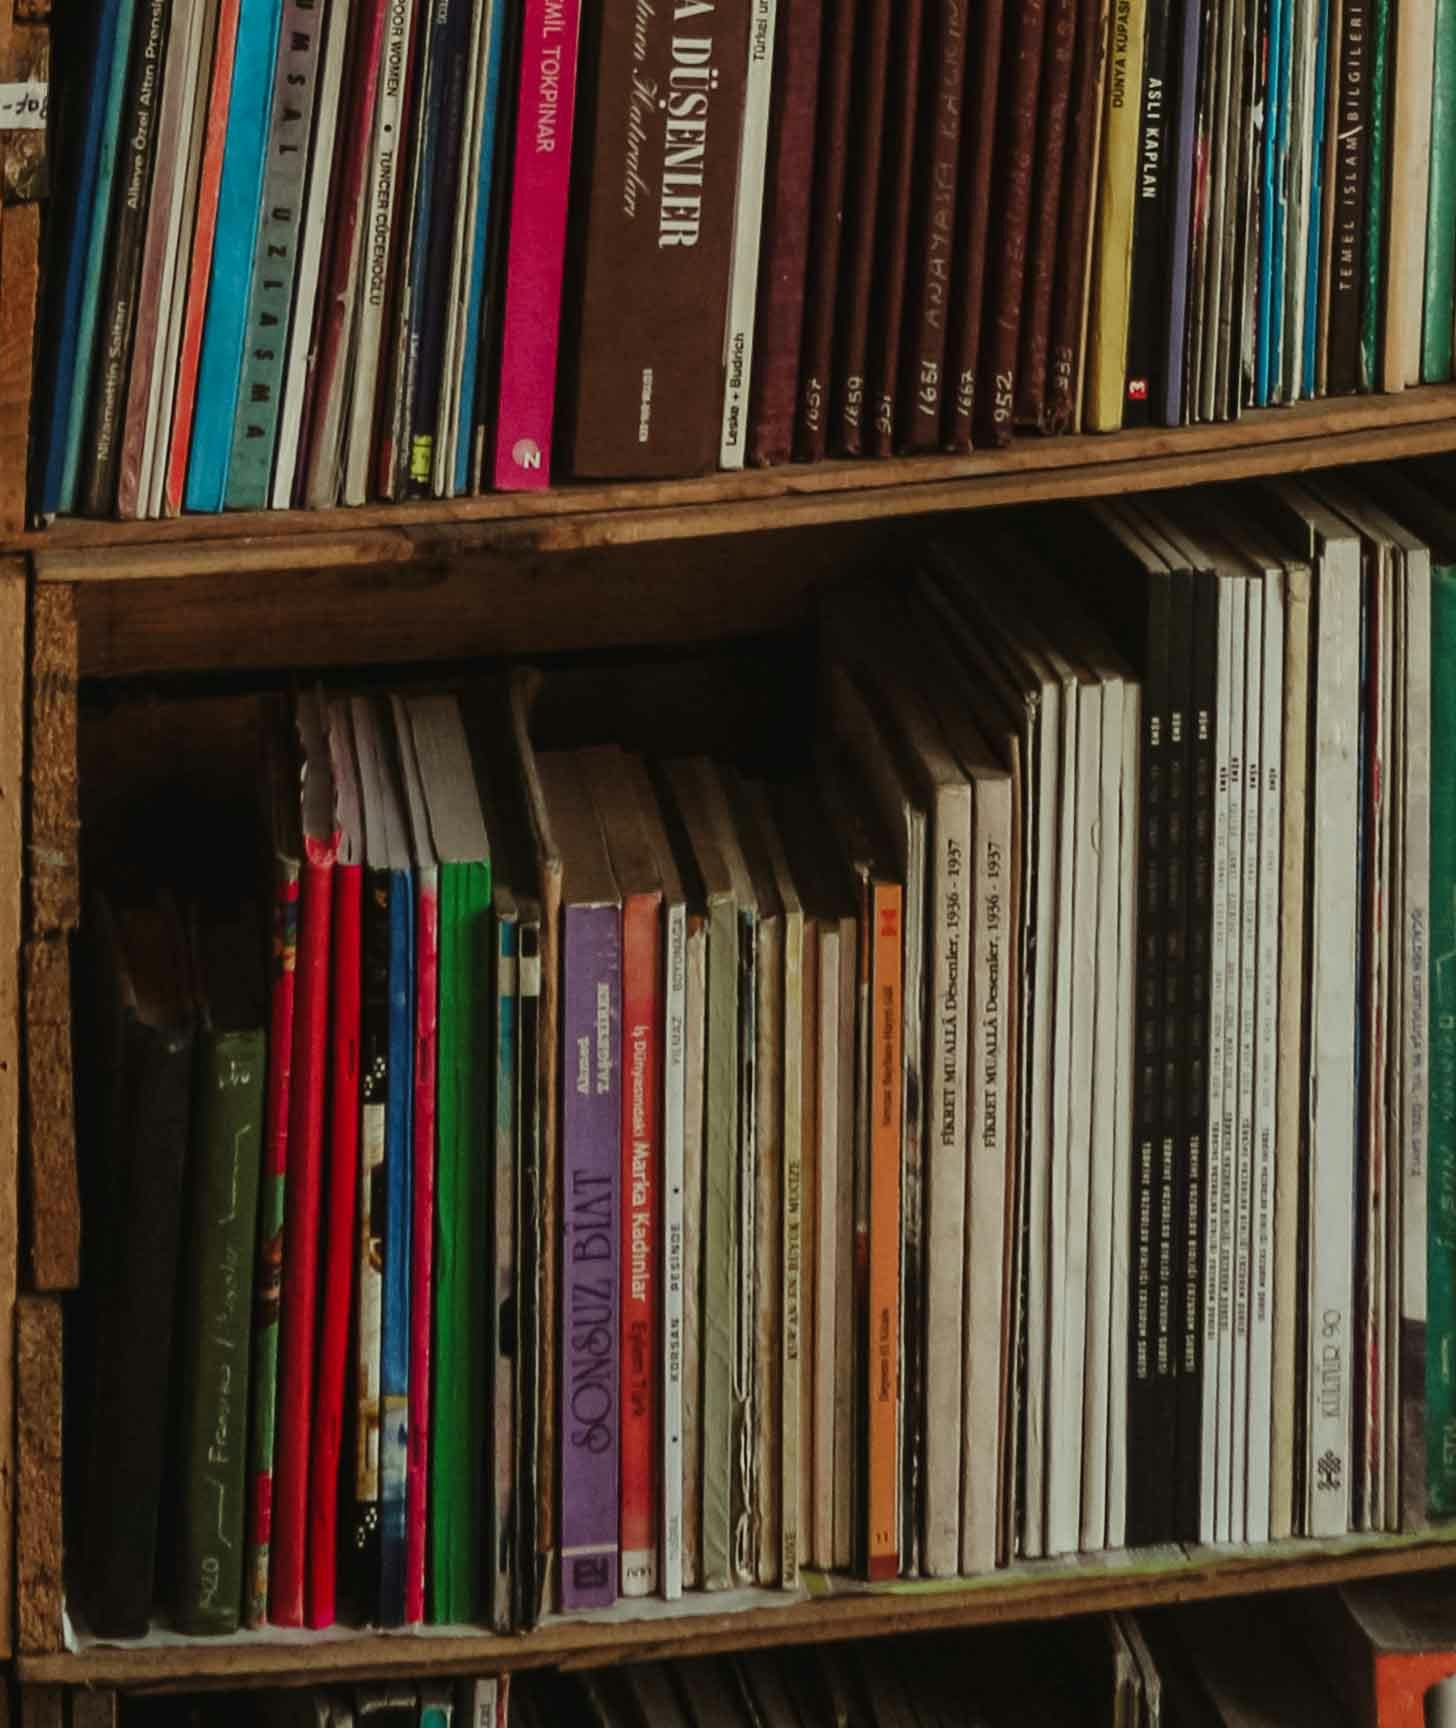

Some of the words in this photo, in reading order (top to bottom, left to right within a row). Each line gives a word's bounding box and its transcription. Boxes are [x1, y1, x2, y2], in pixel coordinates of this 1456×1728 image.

[534, 46, 563, 152] TOKPINAR
[1145, 78, 1164, 120] ASLI
[656, 37, 719, 248] DÜŞENLER
[1142, 127, 1161, 197] KAPLAN
[727, 333, 746, 388] Budrich
